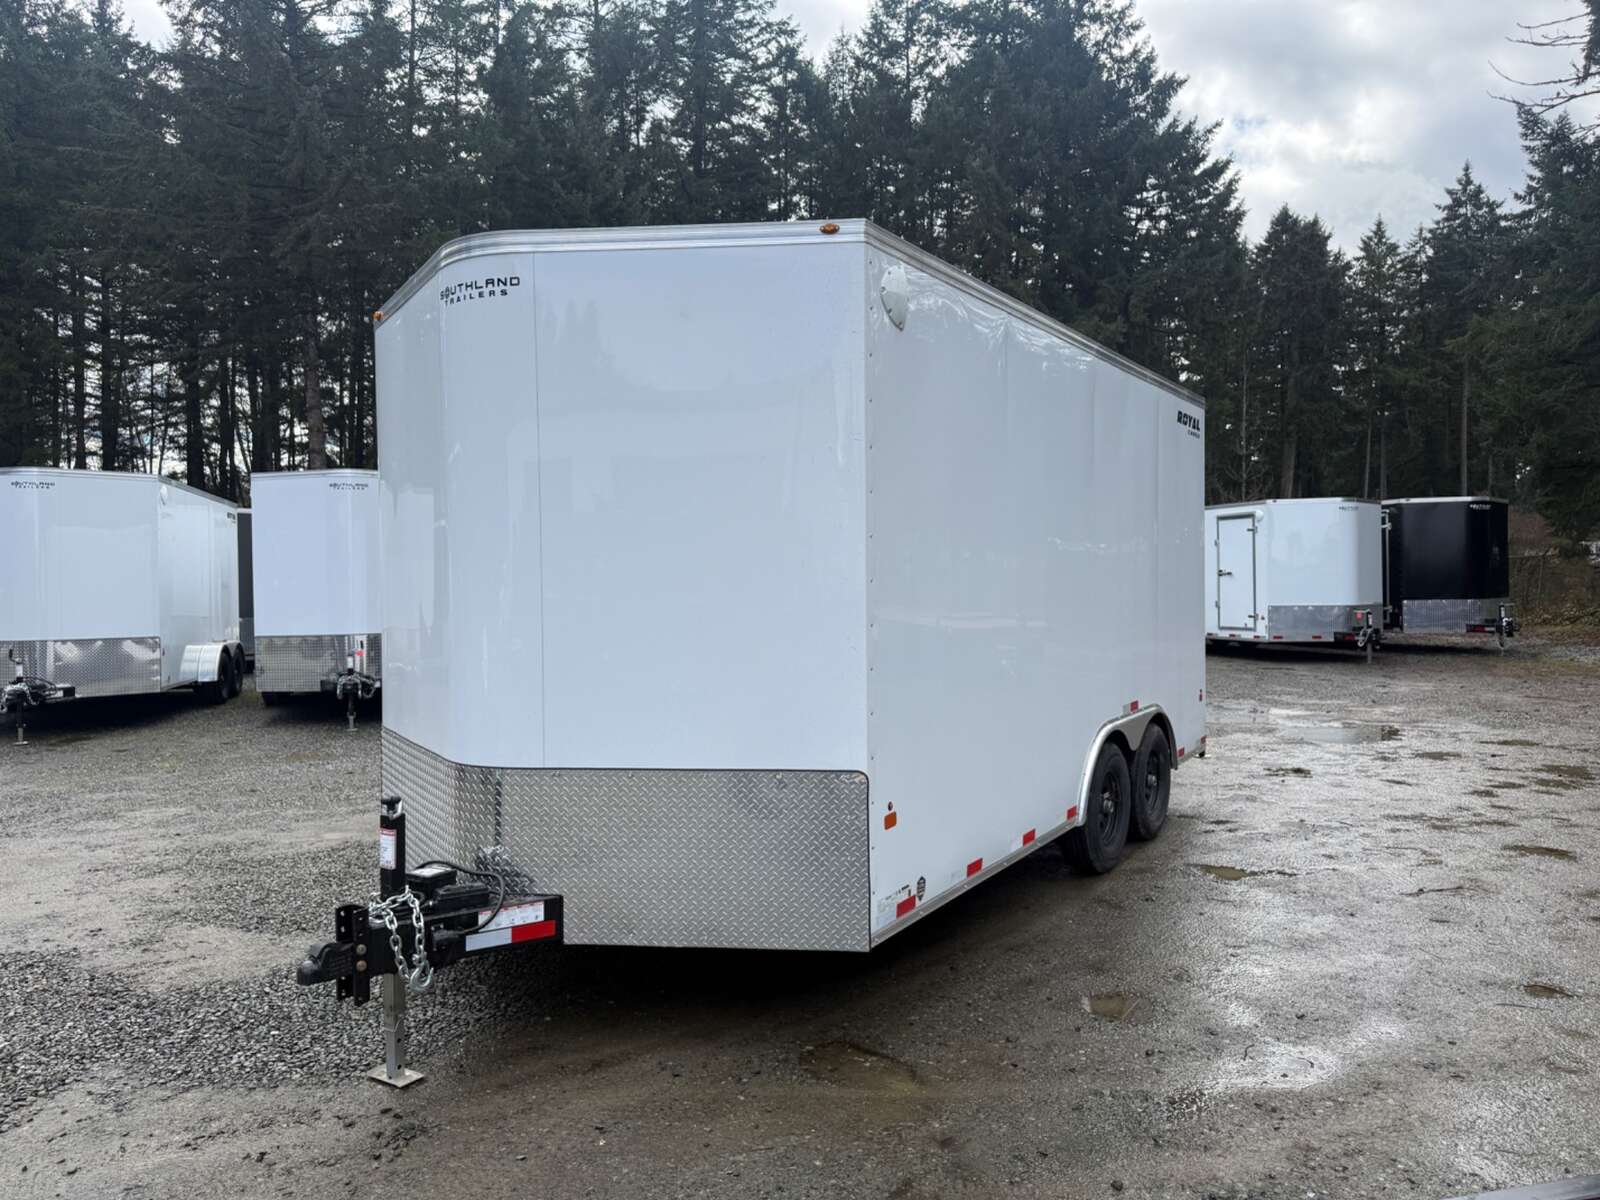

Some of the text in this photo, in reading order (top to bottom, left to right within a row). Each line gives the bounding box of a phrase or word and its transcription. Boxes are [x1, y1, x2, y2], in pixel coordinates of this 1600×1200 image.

[440, 276, 520, 300] SOUTHLAND
[444, 289, 508, 307] TRAILERS
[1177, 410, 1200, 431] ROYAL
